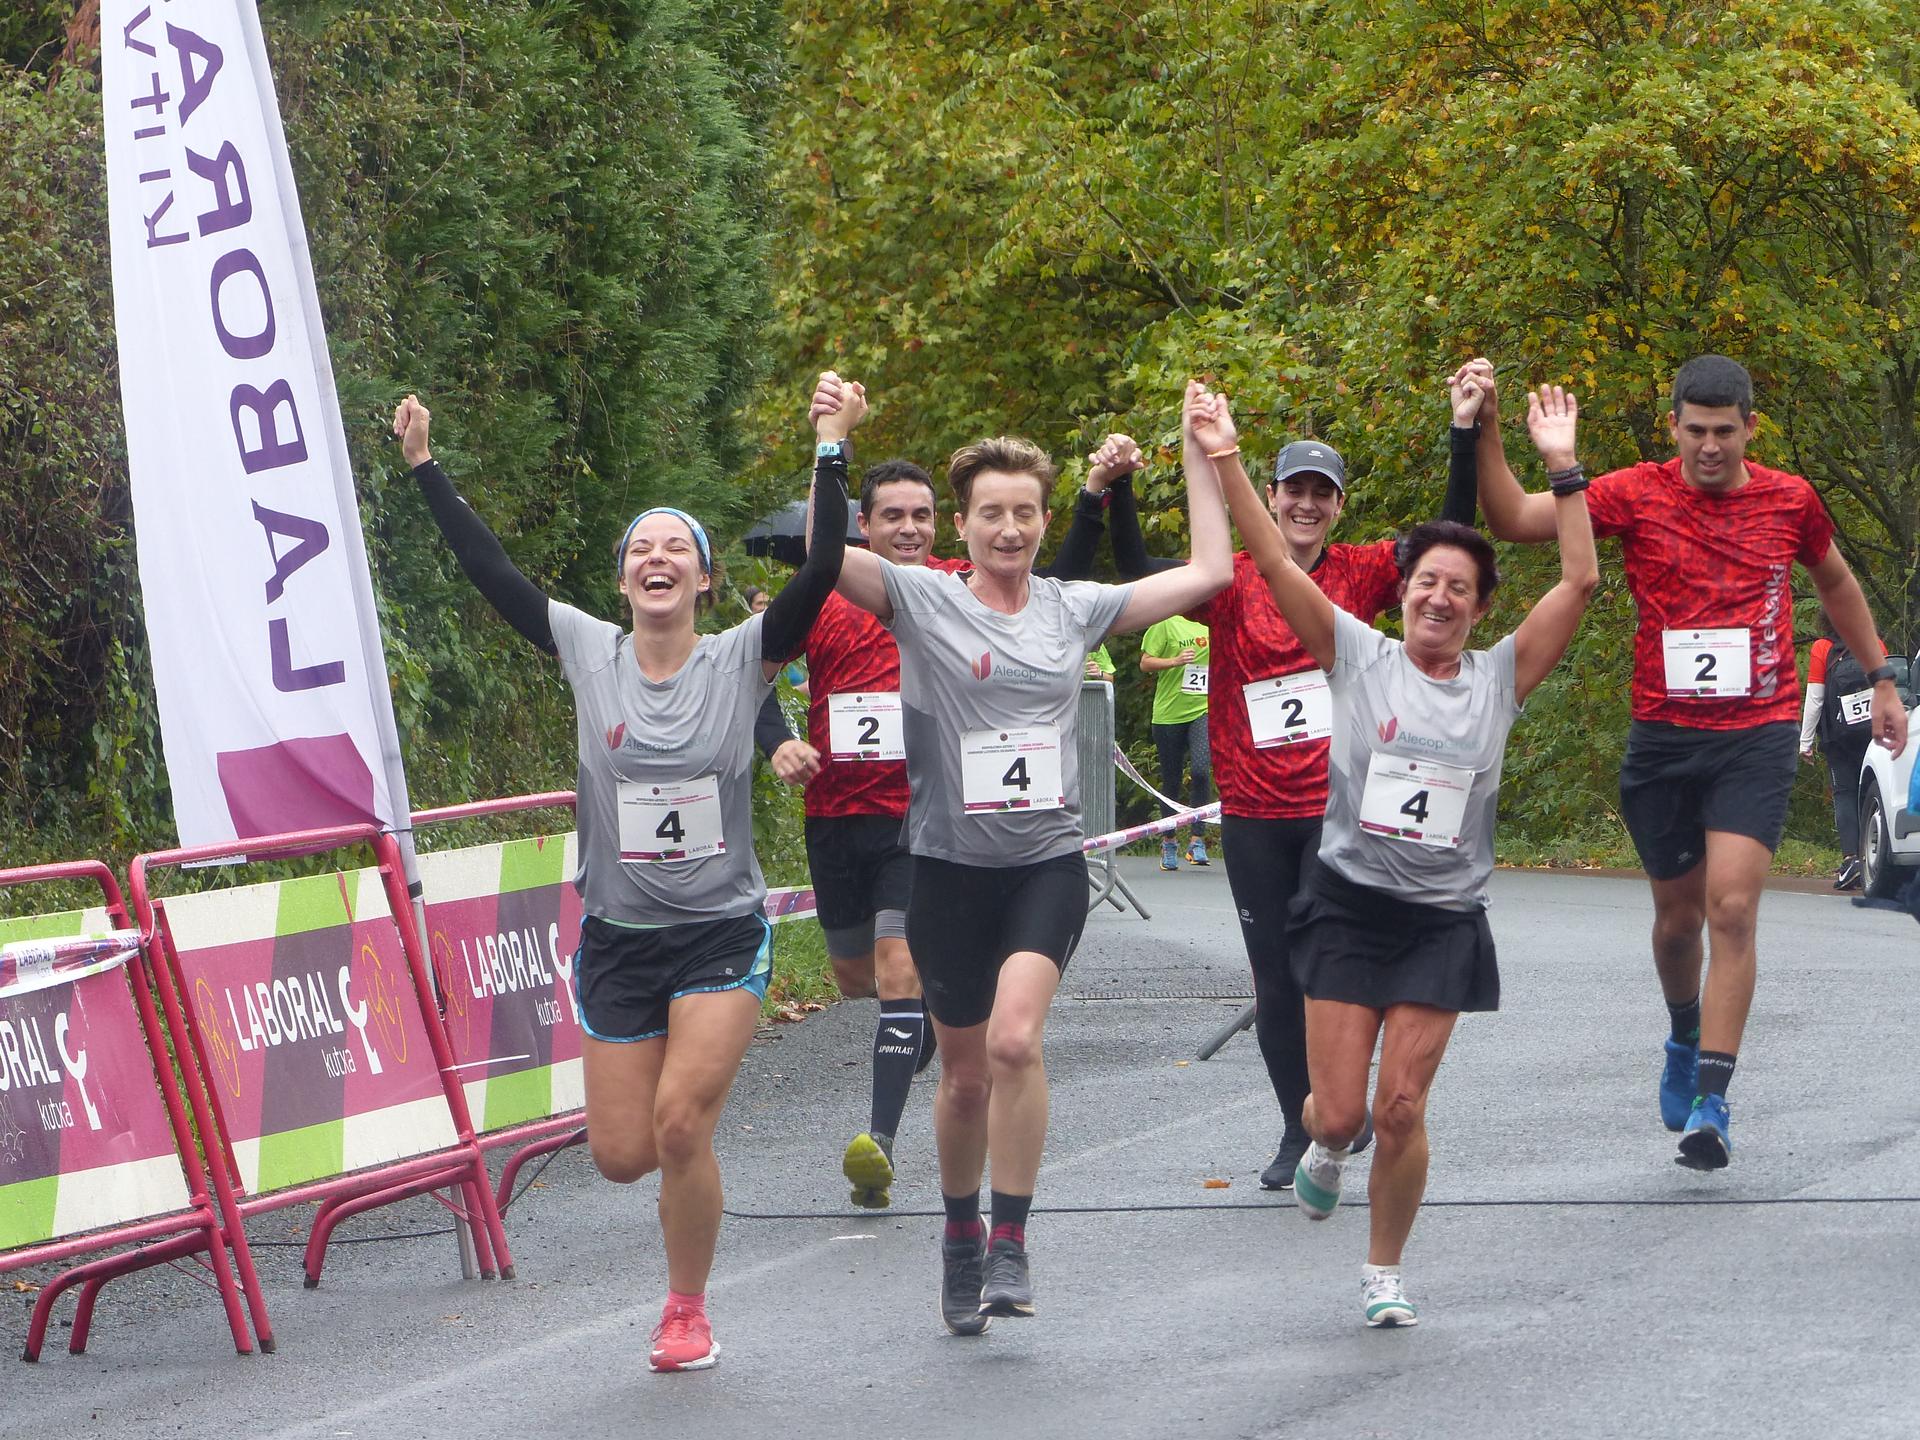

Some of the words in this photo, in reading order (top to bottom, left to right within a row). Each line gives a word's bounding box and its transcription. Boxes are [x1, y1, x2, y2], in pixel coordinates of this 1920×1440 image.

[993, 665, 1037, 680] Alecop
[1694, 653, 1718, 682] 2
[1281, 698, 1307, 729] 2
[1852, 699, 1871, 716] 57
[623, 738, 670, 752] Alecop
[857, 716, 881, 746] 2
[1397, 731, 1444, 750] Alecop
[1002, 756, 1031, 792] 4
[1400, 789, 1430, 824] 4
[656, 810, 685, 844] 4
[461, 927, 553, 999] LABORAL
[225, 971, 344, 1051] LABORAL
[534, 997, 563, 1027] kutxa
[321, 1047, 357, 1079] kutxa
[879, 1045, 914, 1055] SPORTLAST
[37, 1098, 74, 1132] kutxa
